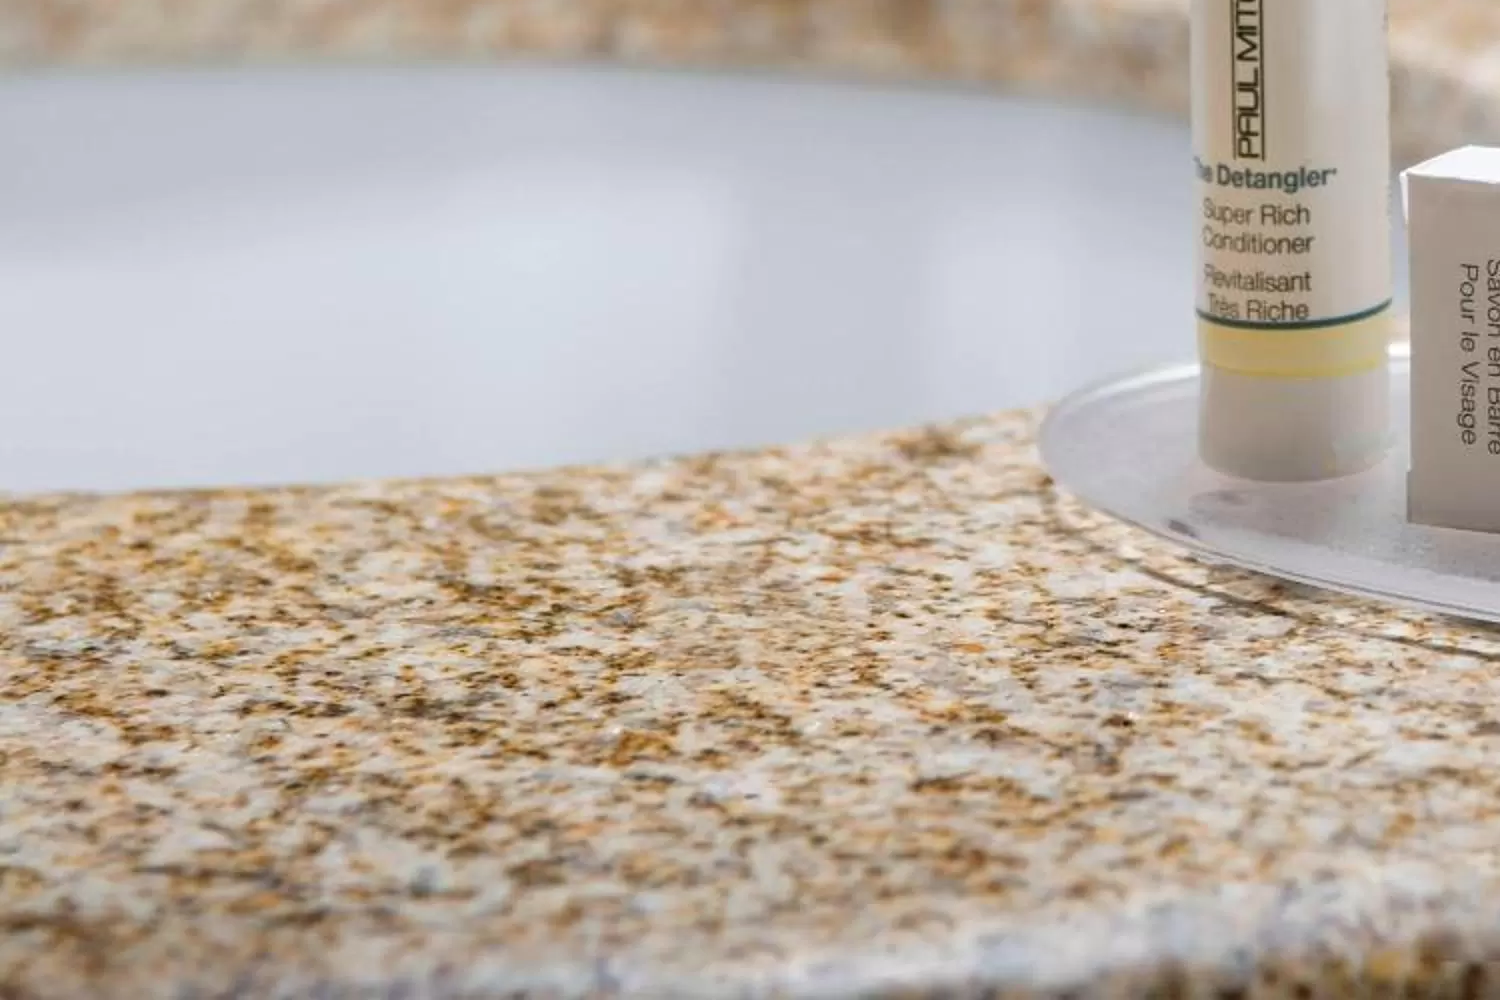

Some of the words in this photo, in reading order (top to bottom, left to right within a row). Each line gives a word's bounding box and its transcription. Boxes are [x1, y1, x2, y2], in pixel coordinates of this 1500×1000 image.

[1236, 67, 1260, 159] PAUL
[1202, 198, 1252, 227] Super
[1261, 204, 1310, 225] Rich
[1203, 225, 1315, 255] Conditioner
[1204, 263, 1312, 293] Revitalisant
[1208, 293, 1240, 318] Très
[1247, 300, 1309, 321] Riche
[1459, 263, 1480, 324] Pour
[1460, 331, 1480, 352] le
[1457, 362, 1481, 445] Visage
